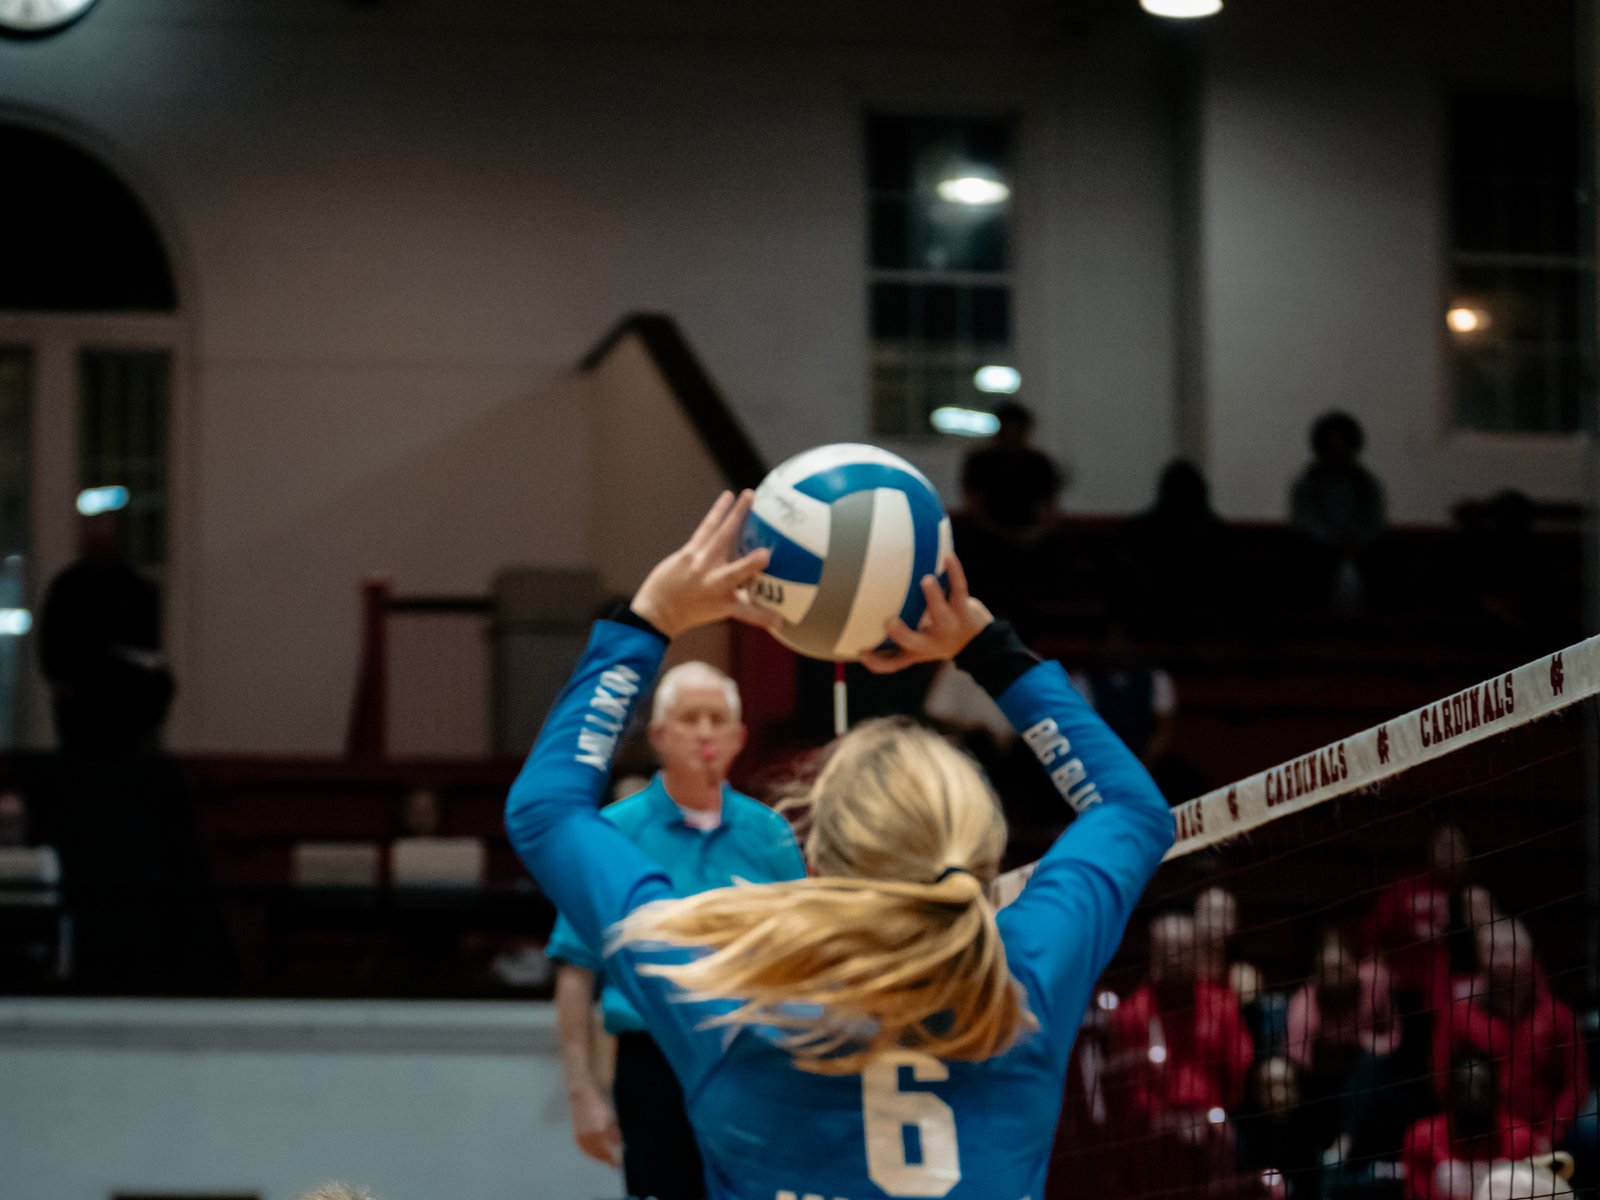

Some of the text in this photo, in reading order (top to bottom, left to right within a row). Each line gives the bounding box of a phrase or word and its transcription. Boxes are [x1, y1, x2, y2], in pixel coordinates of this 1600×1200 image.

[1265, 742, 1349, 808] CARDINALS
[1419, 672, 1515, 748] CARDINALS
[860, 1049, 962, 1198] 6
